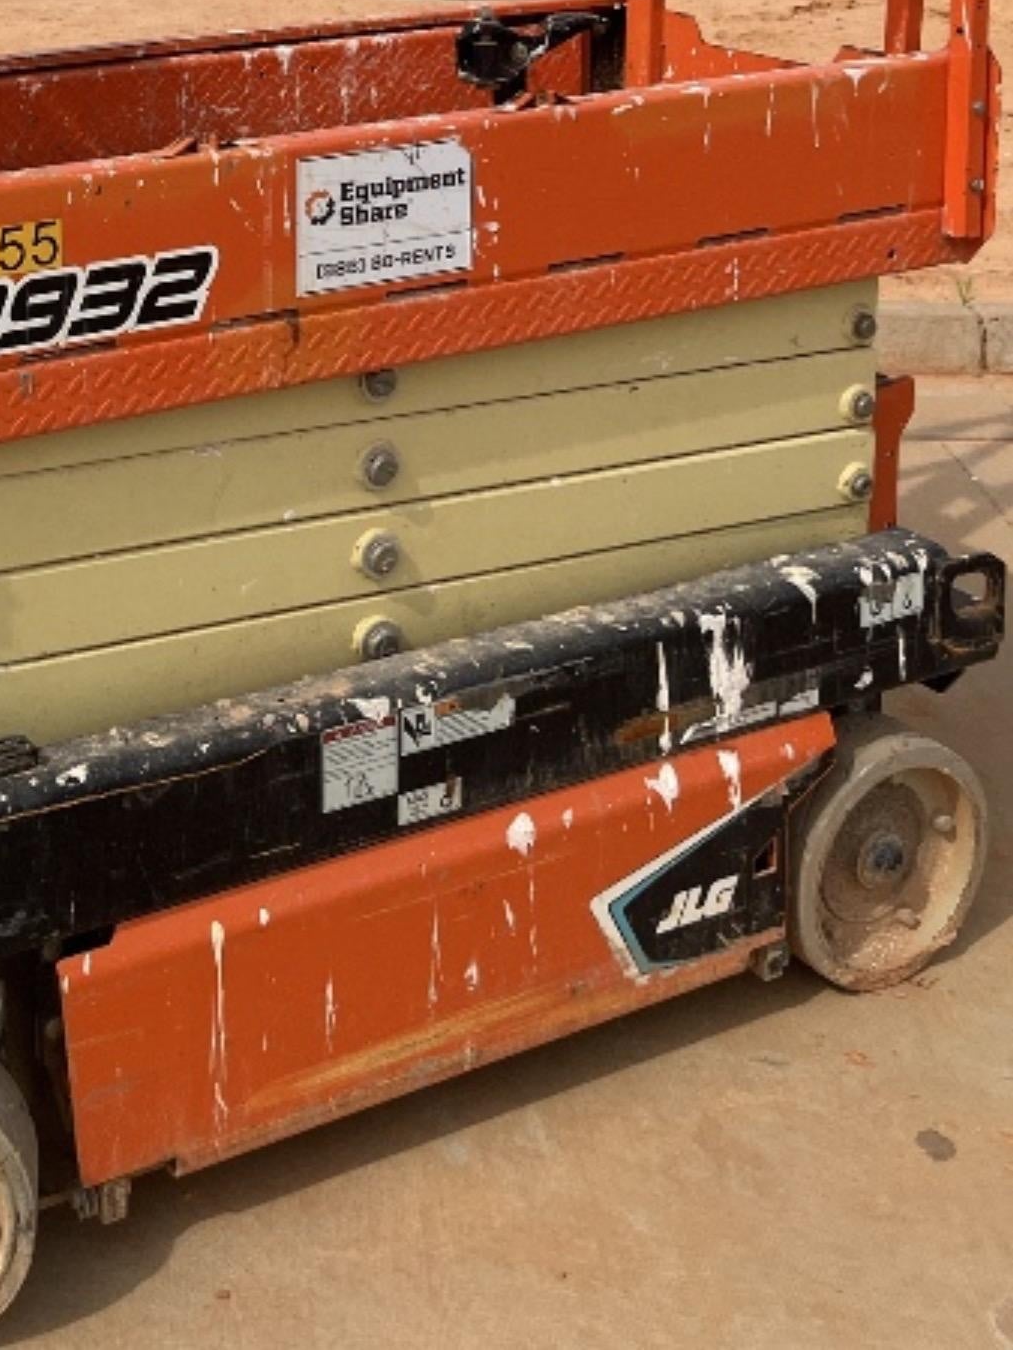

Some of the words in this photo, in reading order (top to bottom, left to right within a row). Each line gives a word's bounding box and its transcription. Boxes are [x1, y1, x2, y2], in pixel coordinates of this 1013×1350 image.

[340, 167, 466, 204] Equipment
[340, 203, 408, 226] Share
[655, 874, 739, 934] JLG
